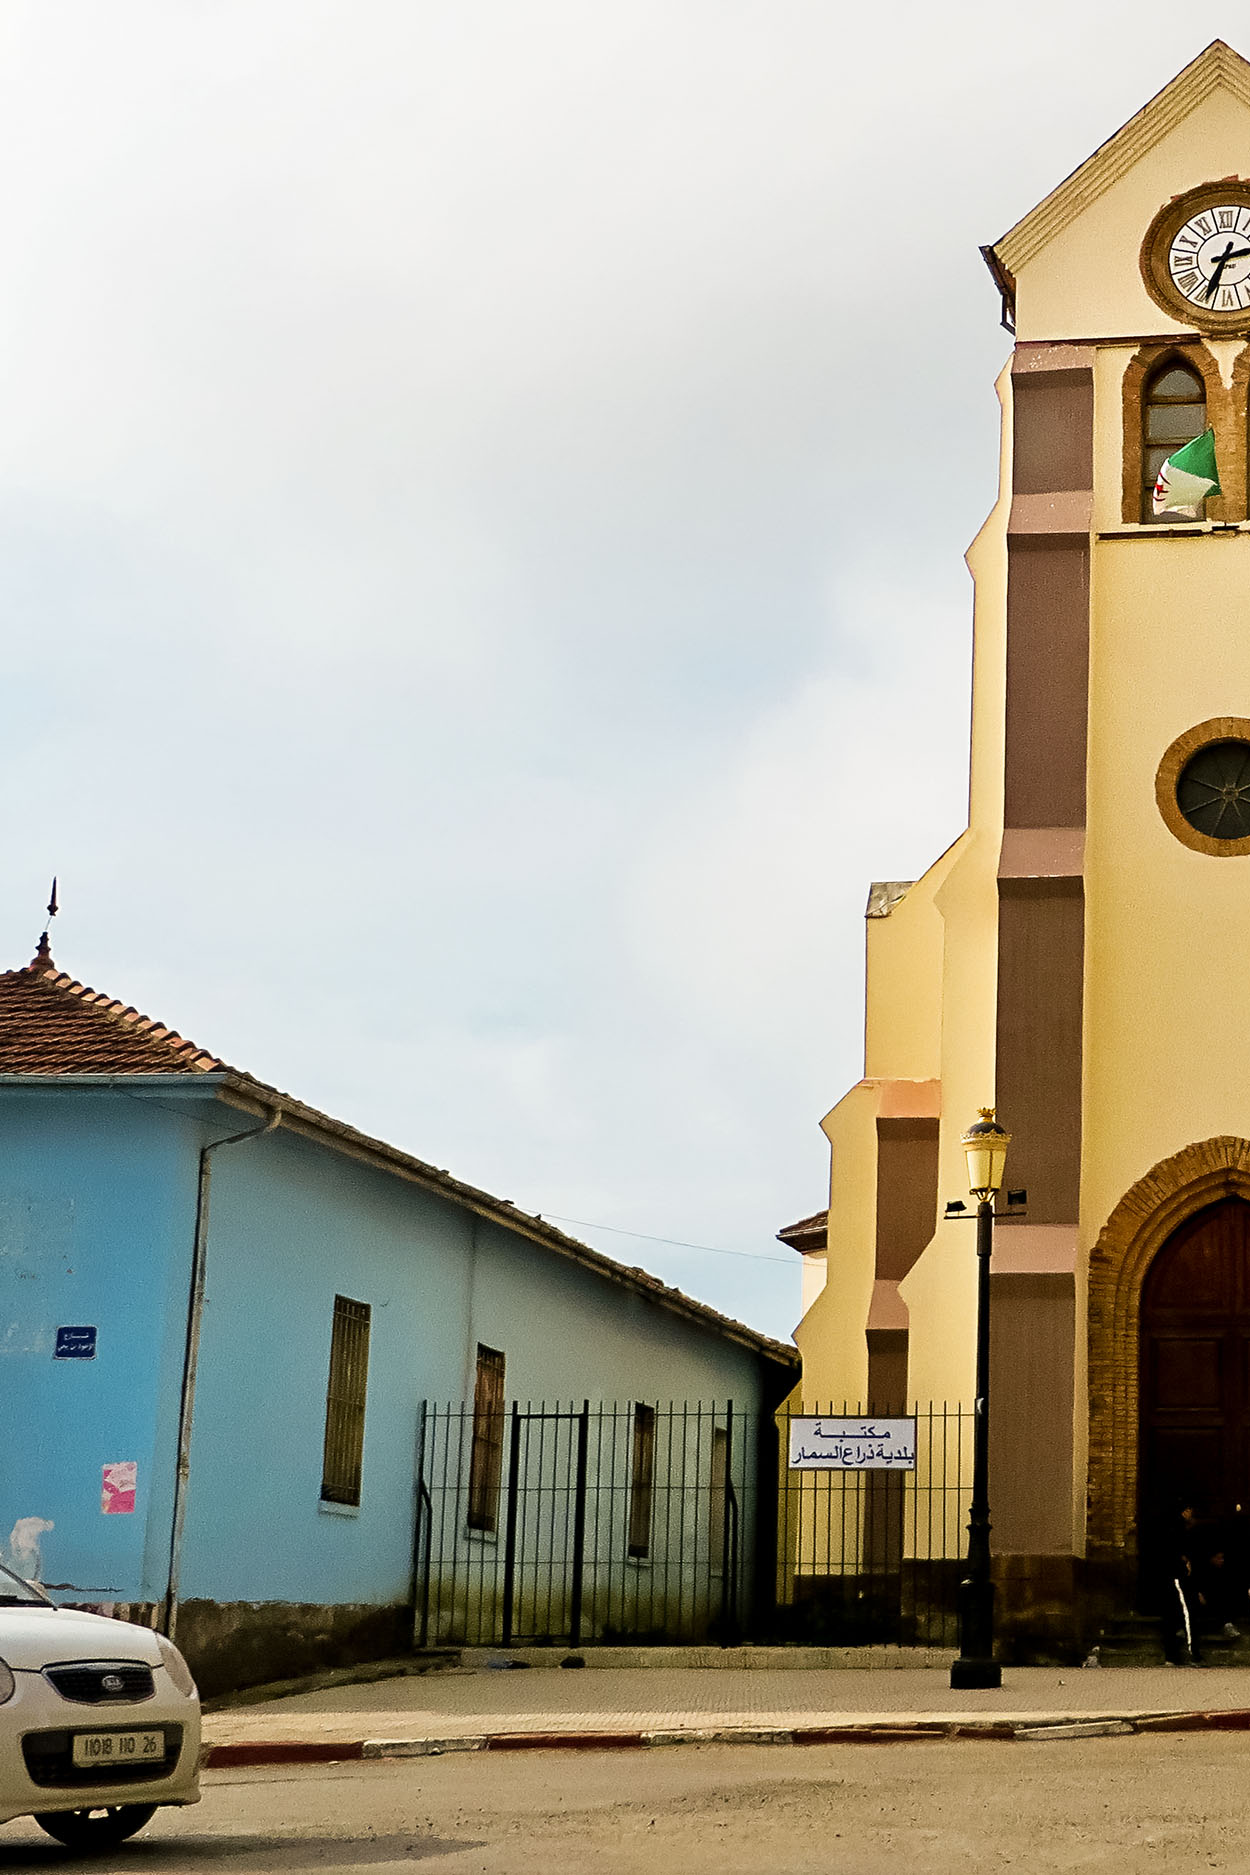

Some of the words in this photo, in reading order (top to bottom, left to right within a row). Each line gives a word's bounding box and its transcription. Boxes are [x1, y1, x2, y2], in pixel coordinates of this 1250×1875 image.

[1194, 216, 1212, 235] XI
[1218, 210, 1234, 229] XII
[1179, 235, 1198, 248] X
[1174, 255, 1193, 267] IX
[1221, 289, 1234, 307] VI
[813, 1422, 891, 1442] مكتبة
[791, 1445, 843, 1463] السمار
[841, 1443, 875, 1466] ذراع
[876, 1443, 915, 1464] بلدية
[119, 1736, 136, 1754] 110
[142, 1735, 157, 1754] 26
